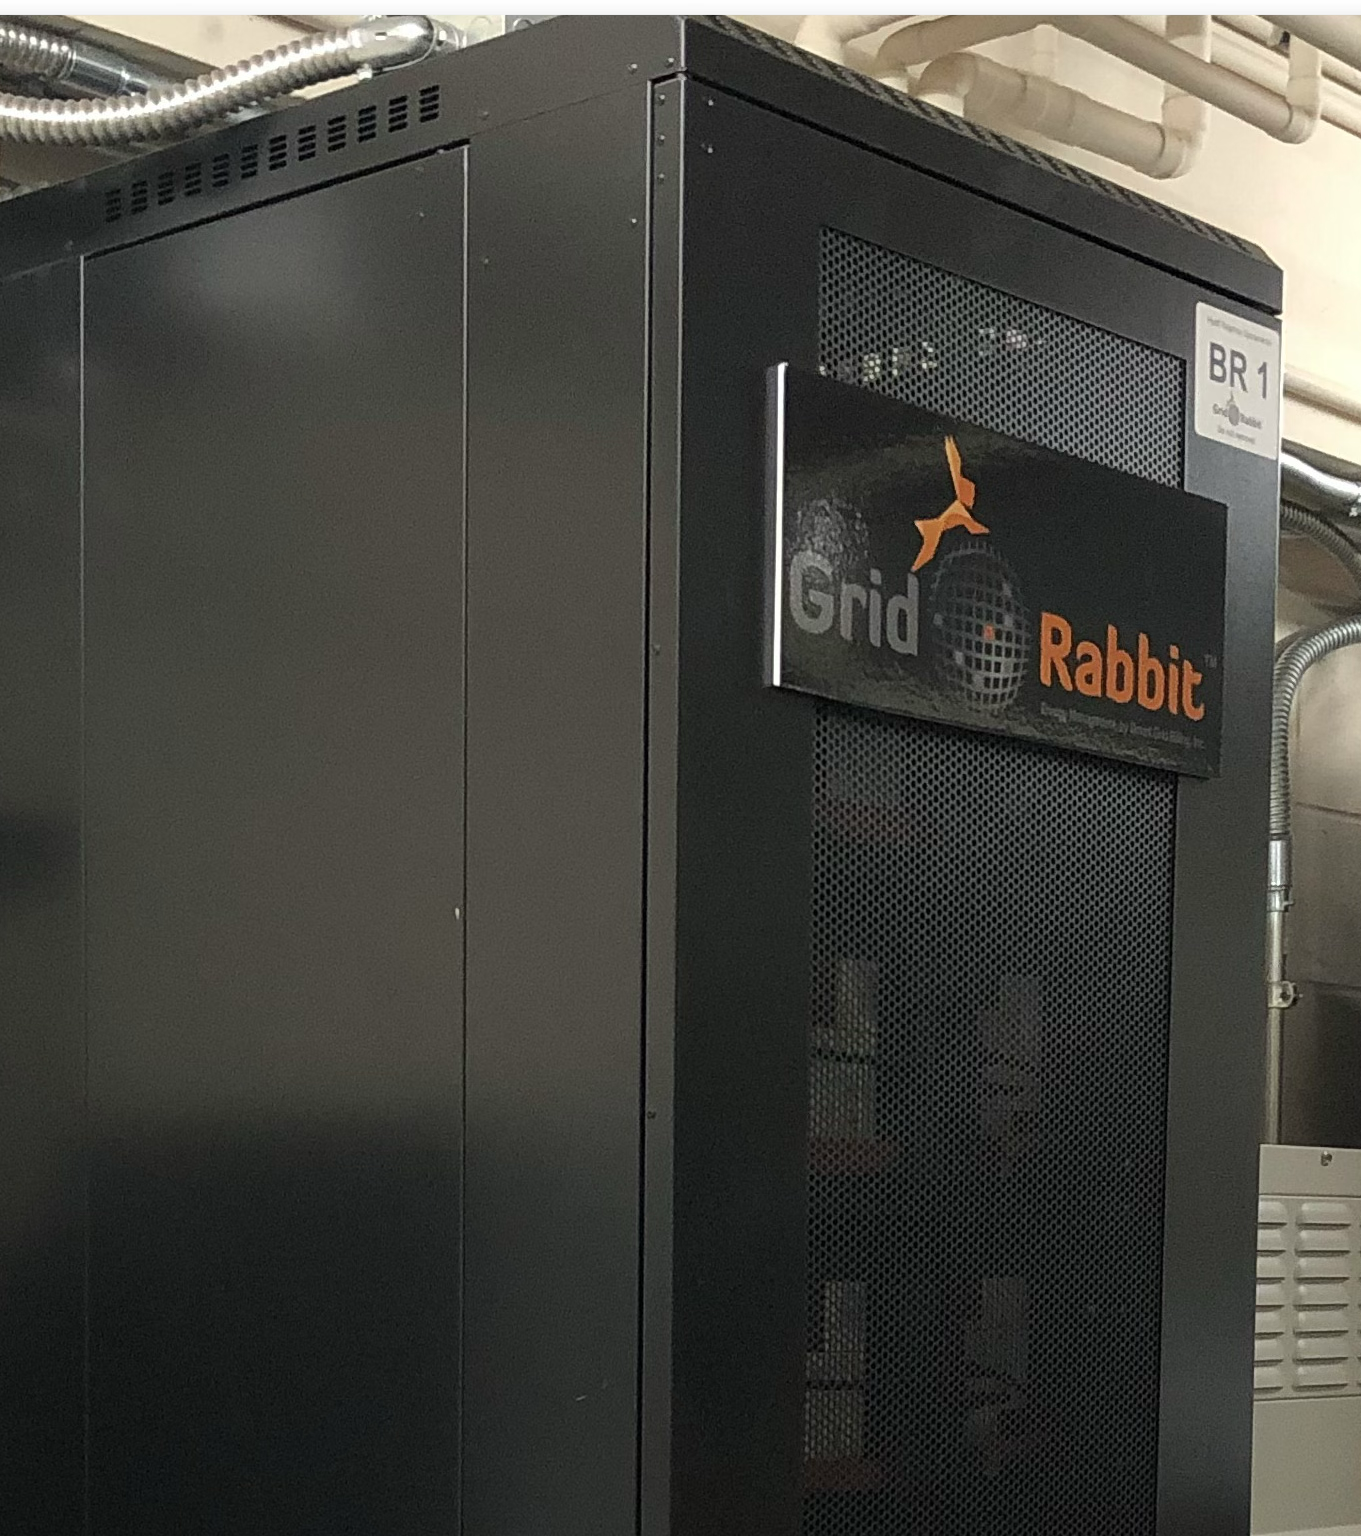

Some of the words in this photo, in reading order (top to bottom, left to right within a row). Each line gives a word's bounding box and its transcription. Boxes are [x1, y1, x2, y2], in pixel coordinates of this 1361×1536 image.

[1209, 341, 1248, 393] BR
[1257, 361, 1268, 400] 1
[790, 550, 919, 656] Grid
[1040, 612, 1205, 722] Rabbit
